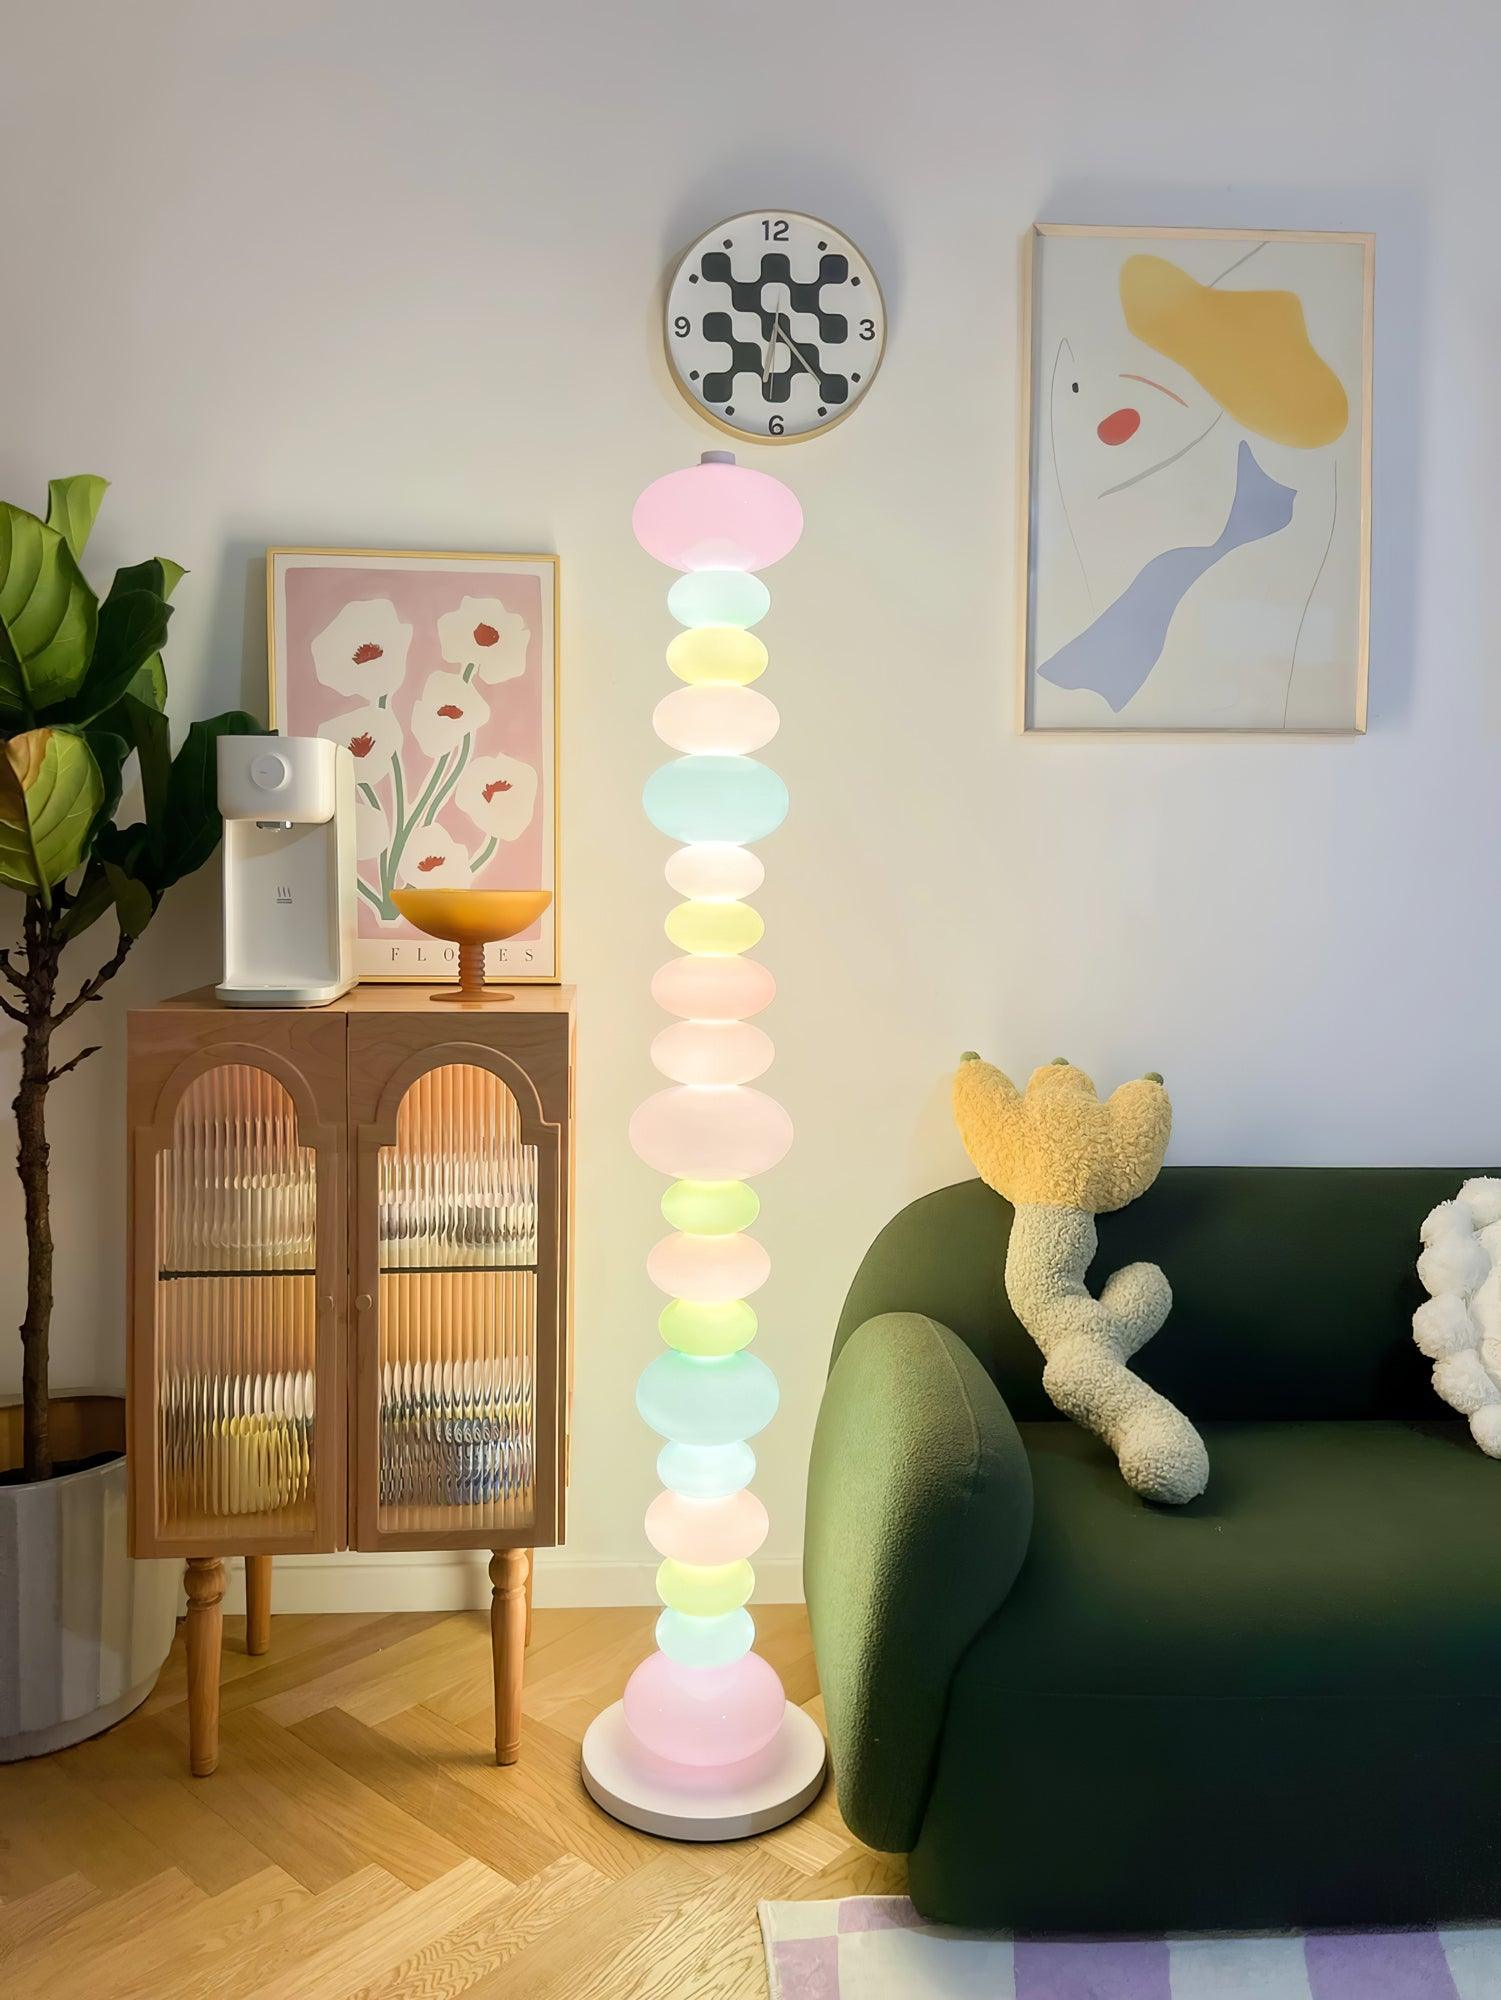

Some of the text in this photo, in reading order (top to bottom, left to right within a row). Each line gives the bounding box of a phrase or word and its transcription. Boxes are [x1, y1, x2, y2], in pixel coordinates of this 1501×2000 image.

[761, 219, 790, 242] 12
[674, 316, 691, 338] 9
[858, 318, 876, 341] 3
[768, 414, 785, 436] 6
[391, 947, 534, 962] FLOES
